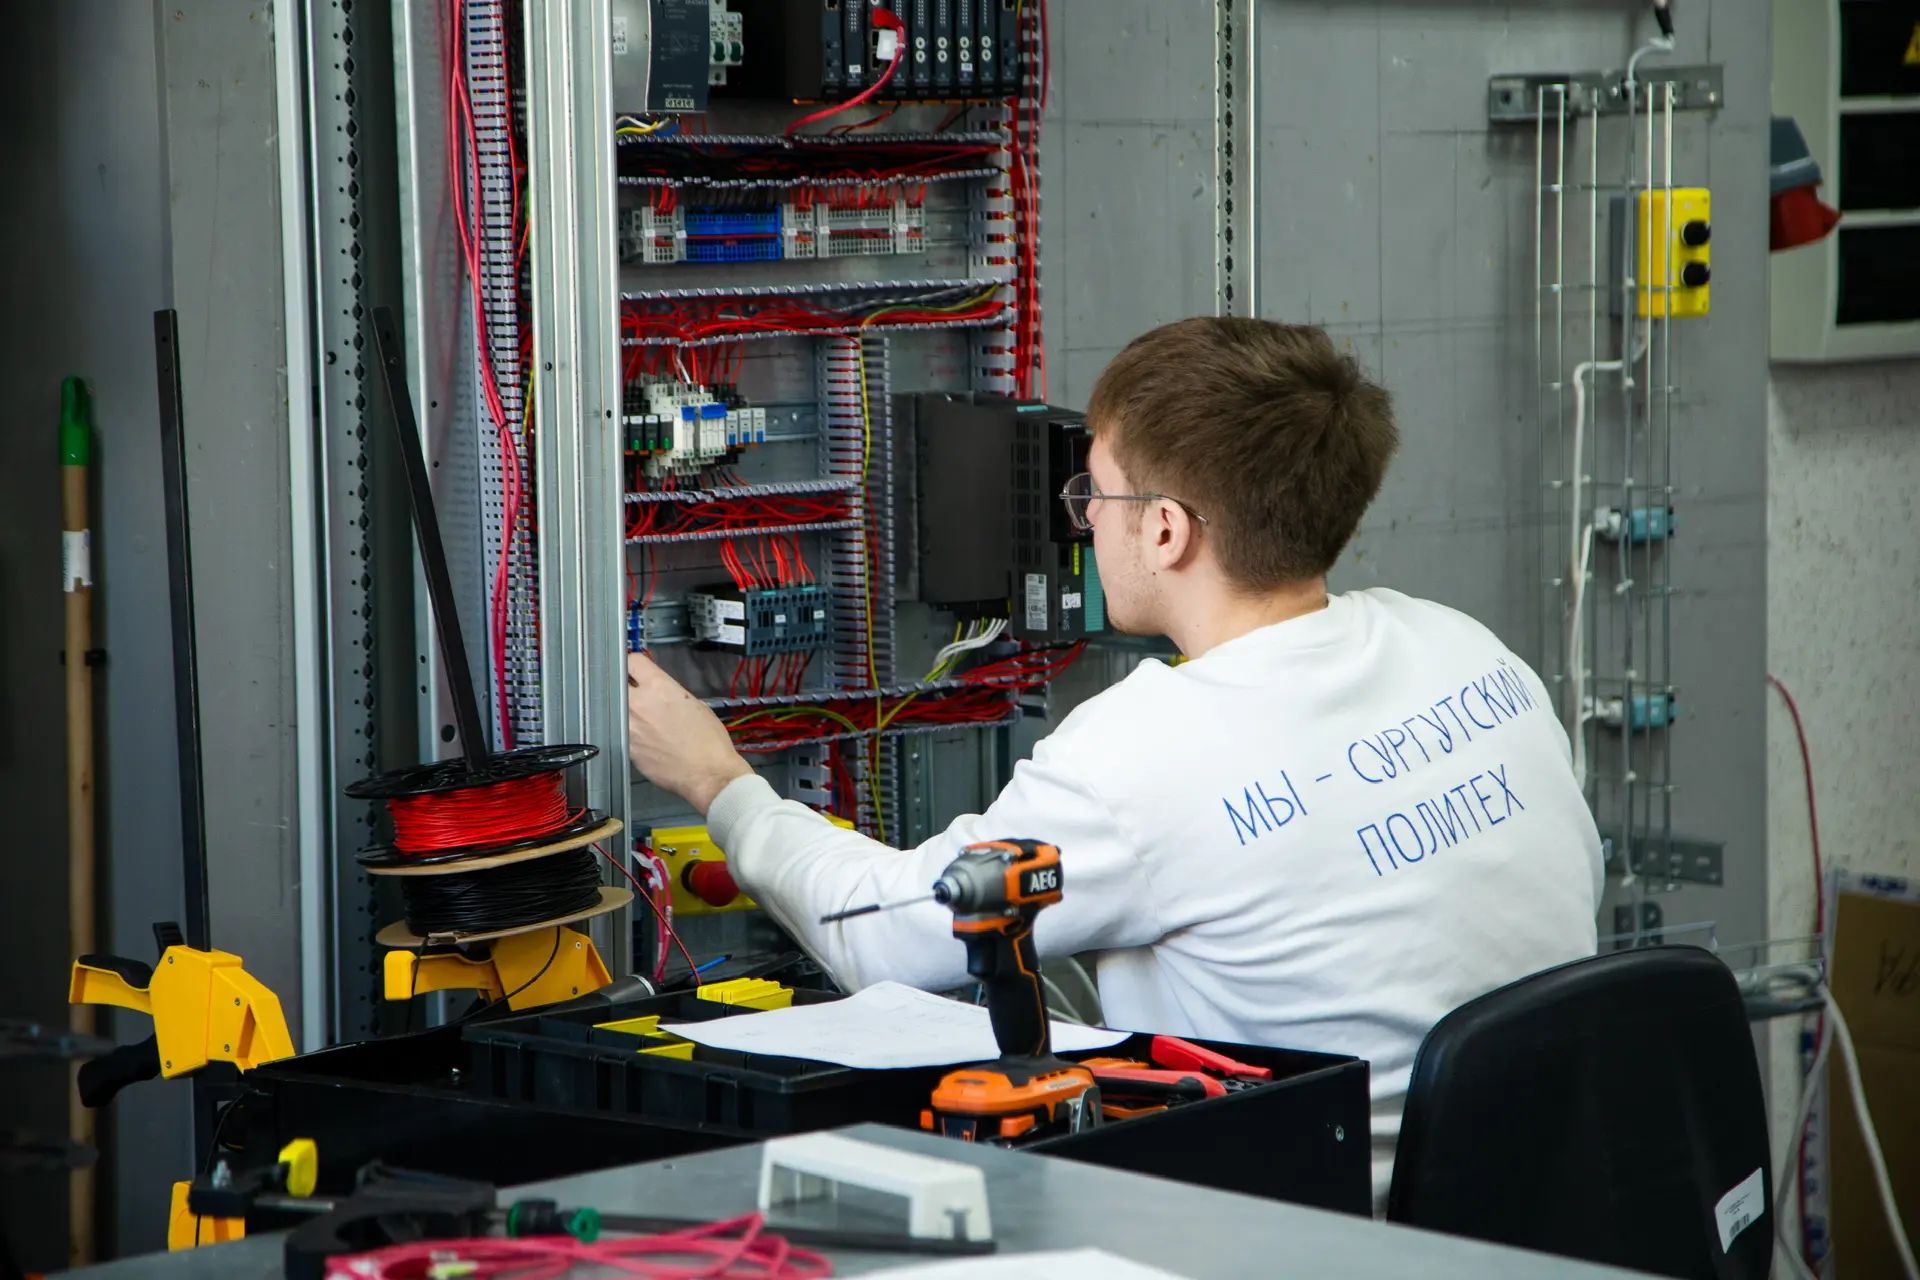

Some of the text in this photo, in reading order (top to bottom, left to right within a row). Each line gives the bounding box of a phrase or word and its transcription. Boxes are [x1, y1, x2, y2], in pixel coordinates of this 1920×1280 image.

[1222, 770, 1308, 846] МЫ
[1348, 657, 1540, 784] СУРГУТСКИЙ
[1356, 764, 1525, 876] ПОЛИТЕХ
[1030, 869, 1057, 893] AEG
